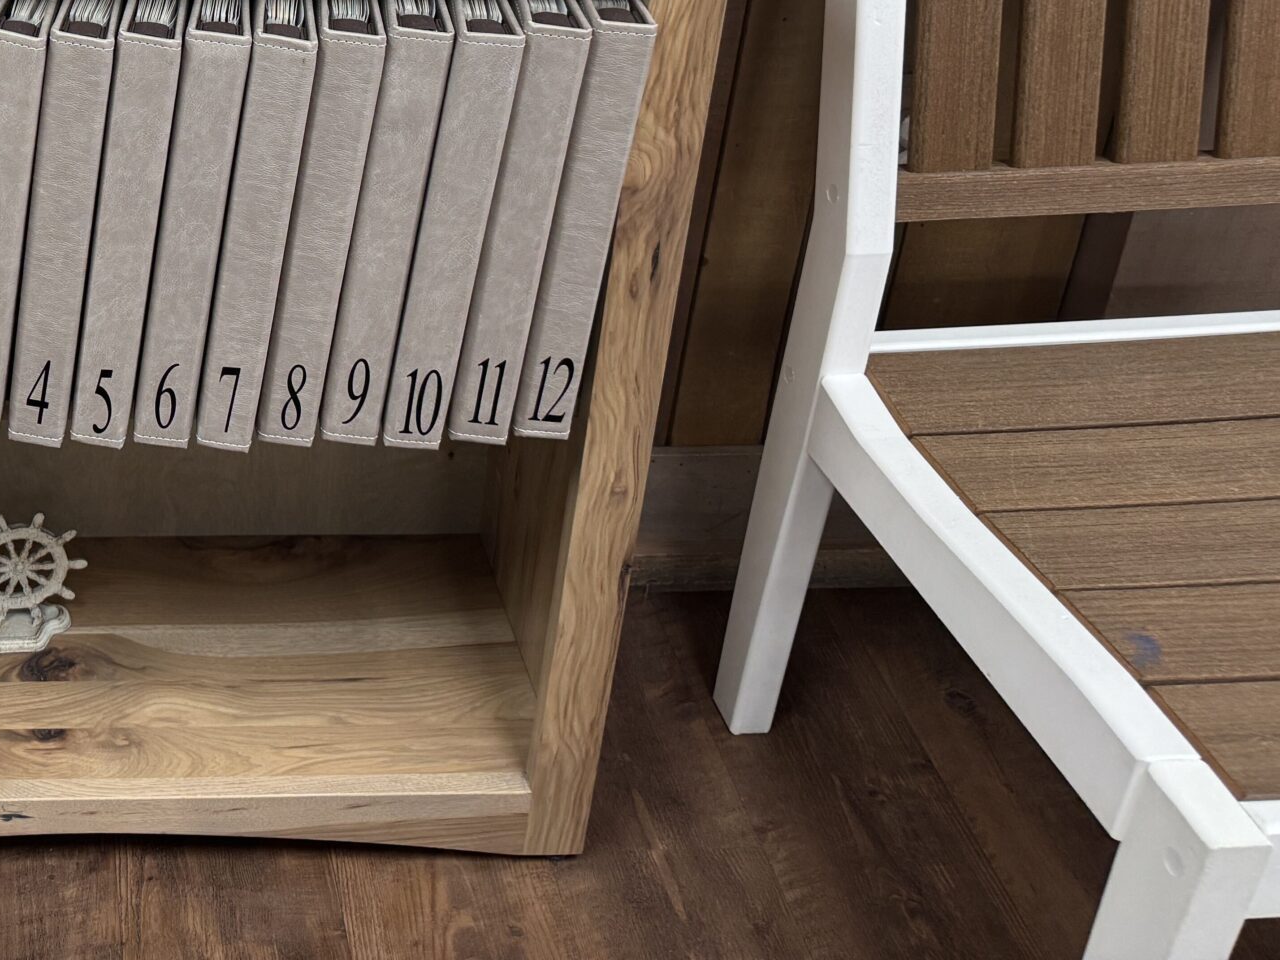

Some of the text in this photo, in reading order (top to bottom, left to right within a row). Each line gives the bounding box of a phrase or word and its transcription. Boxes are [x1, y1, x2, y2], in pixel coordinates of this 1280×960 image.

[26, 360, 51, 425] 4
[92, 369, 113, 434] 5
[154, 363, 180, 429] 6
[219, 367, 241, 433] 7
[281, 364, 307, 431] 8
[342, 358, 371, 425] 9
[399, 368, 443, 436] 10
[467, 357, 507, 426] 11
[527, 356, 575, 423] 12
